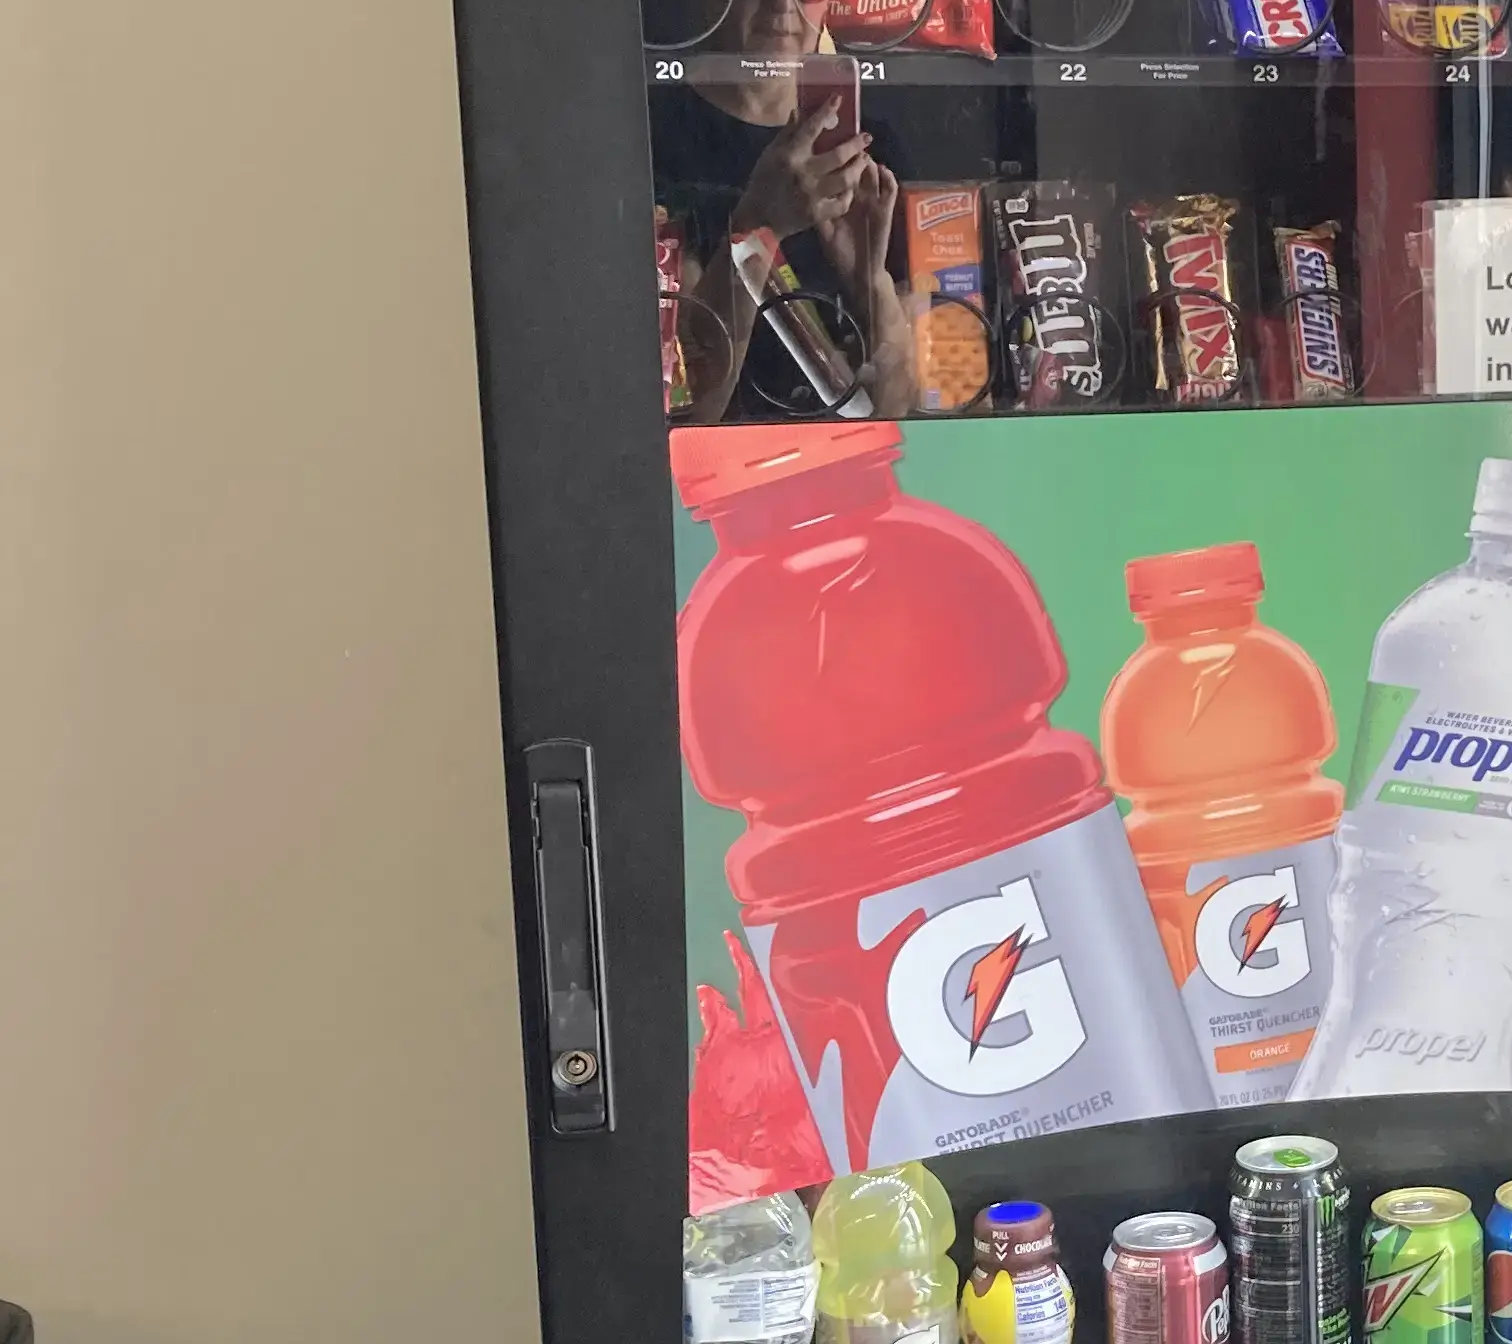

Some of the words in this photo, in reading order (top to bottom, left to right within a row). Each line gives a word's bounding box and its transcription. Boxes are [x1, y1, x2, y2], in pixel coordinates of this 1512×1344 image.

[655, 61, 685, 81] 20
[861, 62, 886, 81] 21
[1060, 64, 1087, 81] 22
[1253, 65, 1279, 83] 23
[1445, 65, 1471, 82] 24
[1164, 226, 1231, 376] TWIX
[1487, 357, 1512, 382] in
[1425, 717, 1497, 734] ELECTROLYTES
[1446, 711, 1479, 723] WATER
[1194, 864, 1312, 998] G
[887, 875, 1089, 1096] G
[1208, 1009, 1264, 1026] GATORADE
[1210, 1022, 1253, 1038] THIRST
[1256, 1006, 1322, 1033] QUENCHER
[1249, 1043, 1291, 1060] ORANGE
[1354, 1027, 1487, 1065] propel
[1013, 1090, 1114, 1140] QUENCHER
[935, 1109, 1022, 1148] GATORADE
[1281, 1224, 1300, 1234] 230
